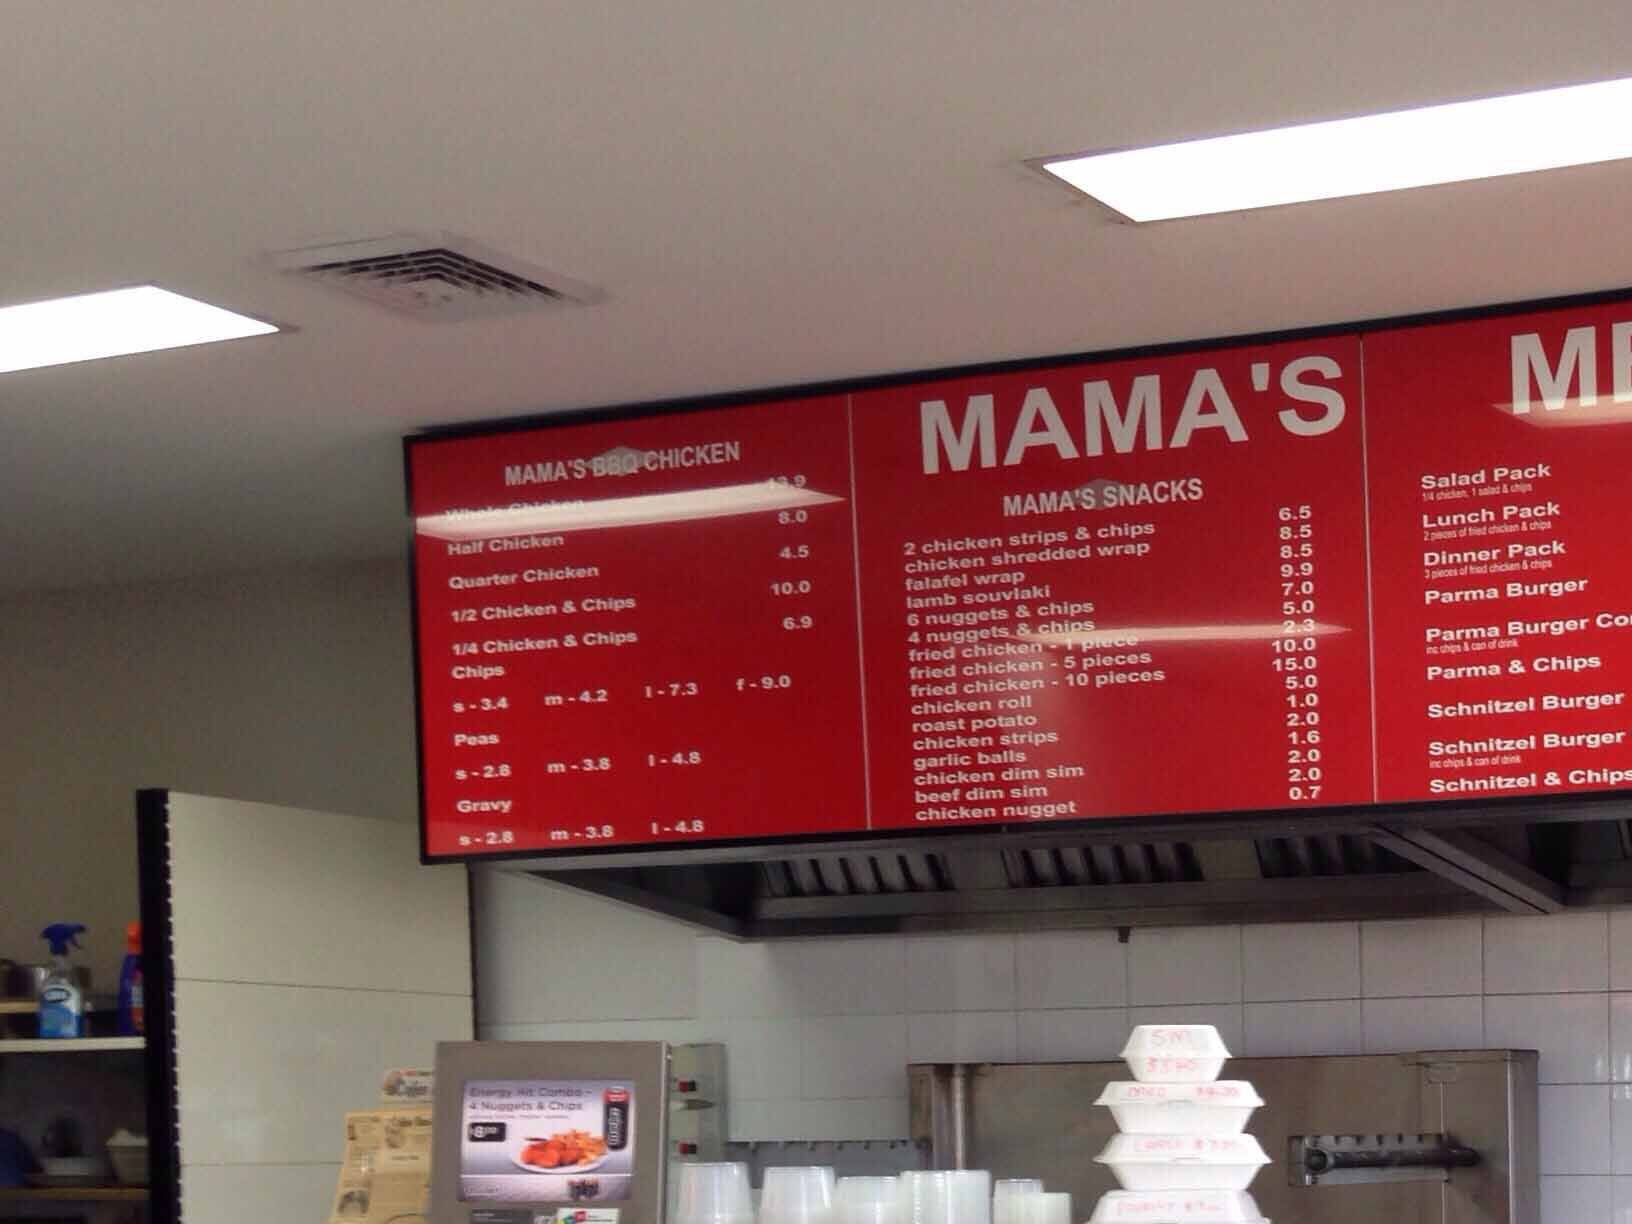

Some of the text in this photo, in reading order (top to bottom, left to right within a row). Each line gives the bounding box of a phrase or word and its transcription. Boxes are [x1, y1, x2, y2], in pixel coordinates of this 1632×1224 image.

[920, 356, 1346, 474] MAMA'S
[505, 441, 740, 486] MAMA'S CHICKEN
[1421, 463, 1551, 489] Salad Pack
[1003, 478, 1203, 517] MAMA'S SNACKS
[778, 509, 807, 524] 8.0
[1279, 505, 1312, 521] 6.5
[1423, 501, 1560, 528] Lunch Pack
[921, 523, 1155, 554] chicken strips chips
[1279, 524, 1312, 540] 8.5
[447, 533, 565, 556] Half Chicken
[779, 544, 809, 559] 4.5
[1280, 543, 1313, 559] 8.5
[1424, 540, 1566, 566] Dinner Pack
[905, 542, 1150, 574] chicken shredded wrap
[448, 566, 599, 589] Quarter Chicken
[1280, 562, 1313, 577] 9.9
[771, 580, 811, 595] 10.0
[905, 571, 1025, 591] falafel wrap
[1281, 581, 1314, 596] 7.0
[906, 585, 1050, 608] lamb souvlaki
[1425, 579, 1588, 605] Parma Burger
[451, 597, 636, 622] 1/2 Chicken Chips
[925, 601, 1094, 626] nuggets chips
[1283, 599, 1314, 615] 5.0
[782, 615, 813, 630] 6.9
[1426, 626, 1500, 642] Parma
[1508, 618, 1589, 636] Burger
[452, 631, 638, 656] 1/4 Chicken Chips
[924, 625, 1012, 645] nuggets
[908, 645, 956, 662] fried
[1272, 637, 1316, 653] 10.0
[451, 665, 505, 680] Chips
[909, 653, 1152, 680] fried chicken pieces
[1272, 656, 1317, 671] 15.0
[1427, 656, 1601, 680] Parma Chips
[669, 682, 698, 696] 7.3
[761, 675, 791, 689] 9.0
[910, 670, 1165, 697] fried chicken 10 pieces
[1285, 674, 1318, 690] 5.0
[481, 696, 508, 711] 3.4
[579, 689, 608, 703] 4.2
[911, 694, 1032, 715] chicken roll
[1286, 693, 1318, 708] 1.0
[1428, 693, 1624, 718] Schnitzel Burger
[912, 713, 1038, 732] roast potato
[1287, 711, 1319, 726] 2.0
[454, 734, 500, 746] Peas
[913, 731, 1059, 750] chicken strips
[1288, 730, 1320, 744] 1.6
[1429, 735, 1536, 756] Schnitzel
[1543, 732, 1625, 748] Burger
[913, 749, 1028, 771] garlic balls
[1288, 749, 1320, 763] 2.0
[914, 765, 1084, 786] chicken dim sim
[1289, 767, 1321, 782] 2.0
[1430, 773, 1537, 793] Schnitzel
[915, 785, 1048, 803] beef dim sim
[1289, 785, 1321, 800] 0.7
[456, 800, 512, 813] Gravy
[915, 800, 1077, 821] chicken nugget
